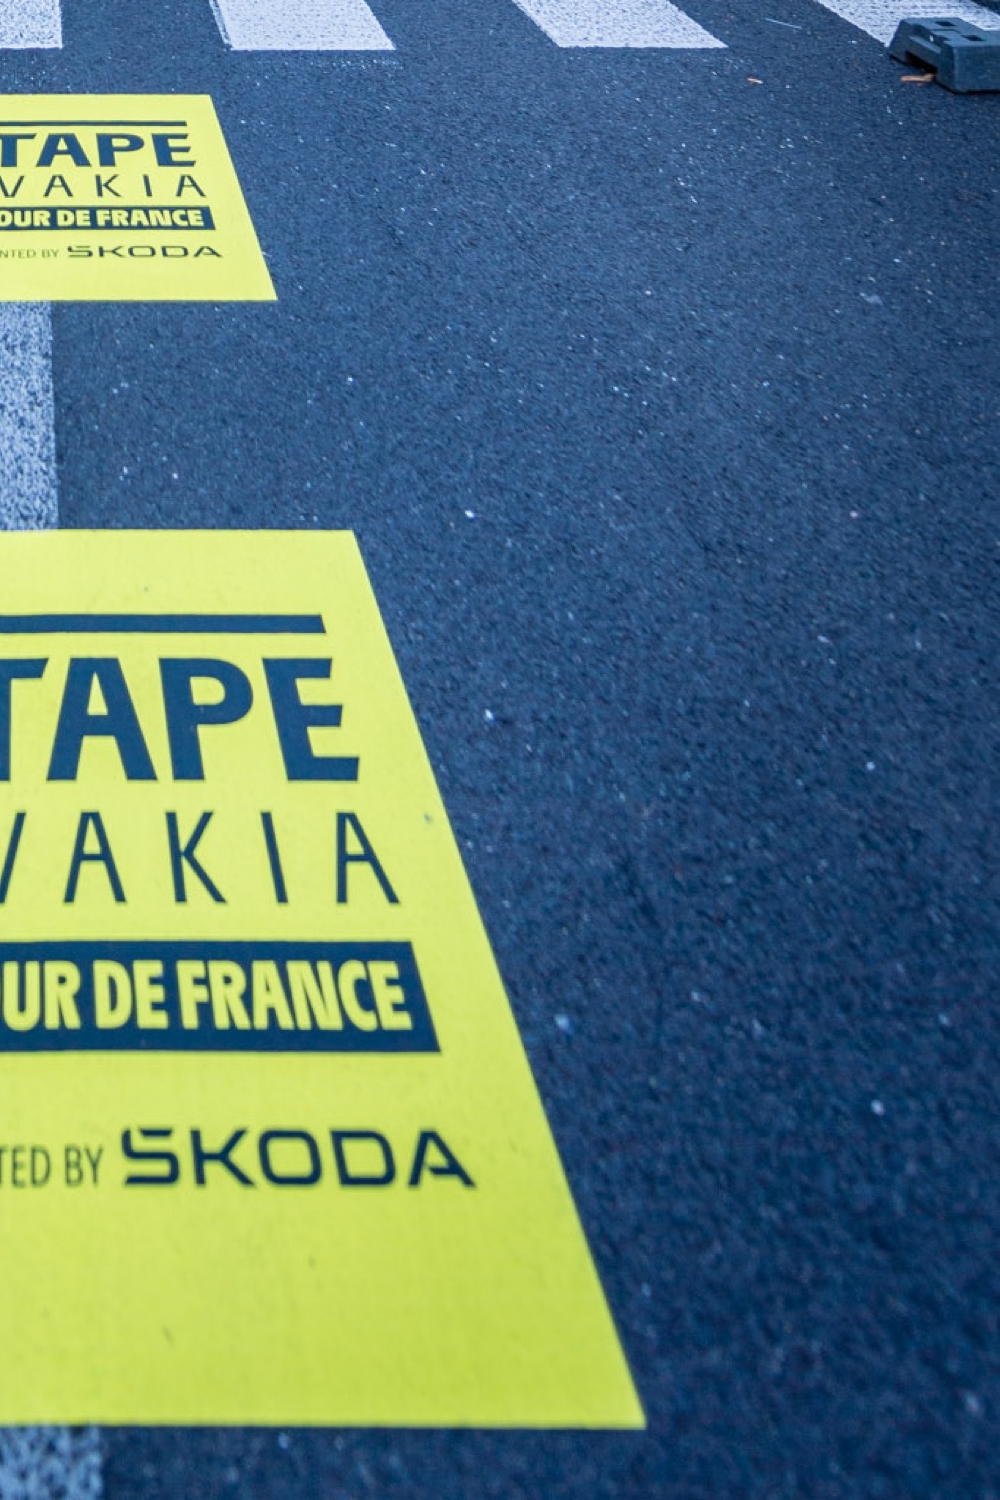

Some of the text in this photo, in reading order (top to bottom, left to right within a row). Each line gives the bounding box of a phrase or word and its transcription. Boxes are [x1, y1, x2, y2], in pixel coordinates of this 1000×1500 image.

[56, 209, 92, 228] DE
[96, 209, 204, 228] FRANCE
[41, 248, 60, 260] BY
[92, 958, 169, 1032] DE
[176, 958, 414, 1032] FRANCE
[64, 1144, 104, 1190] BY
